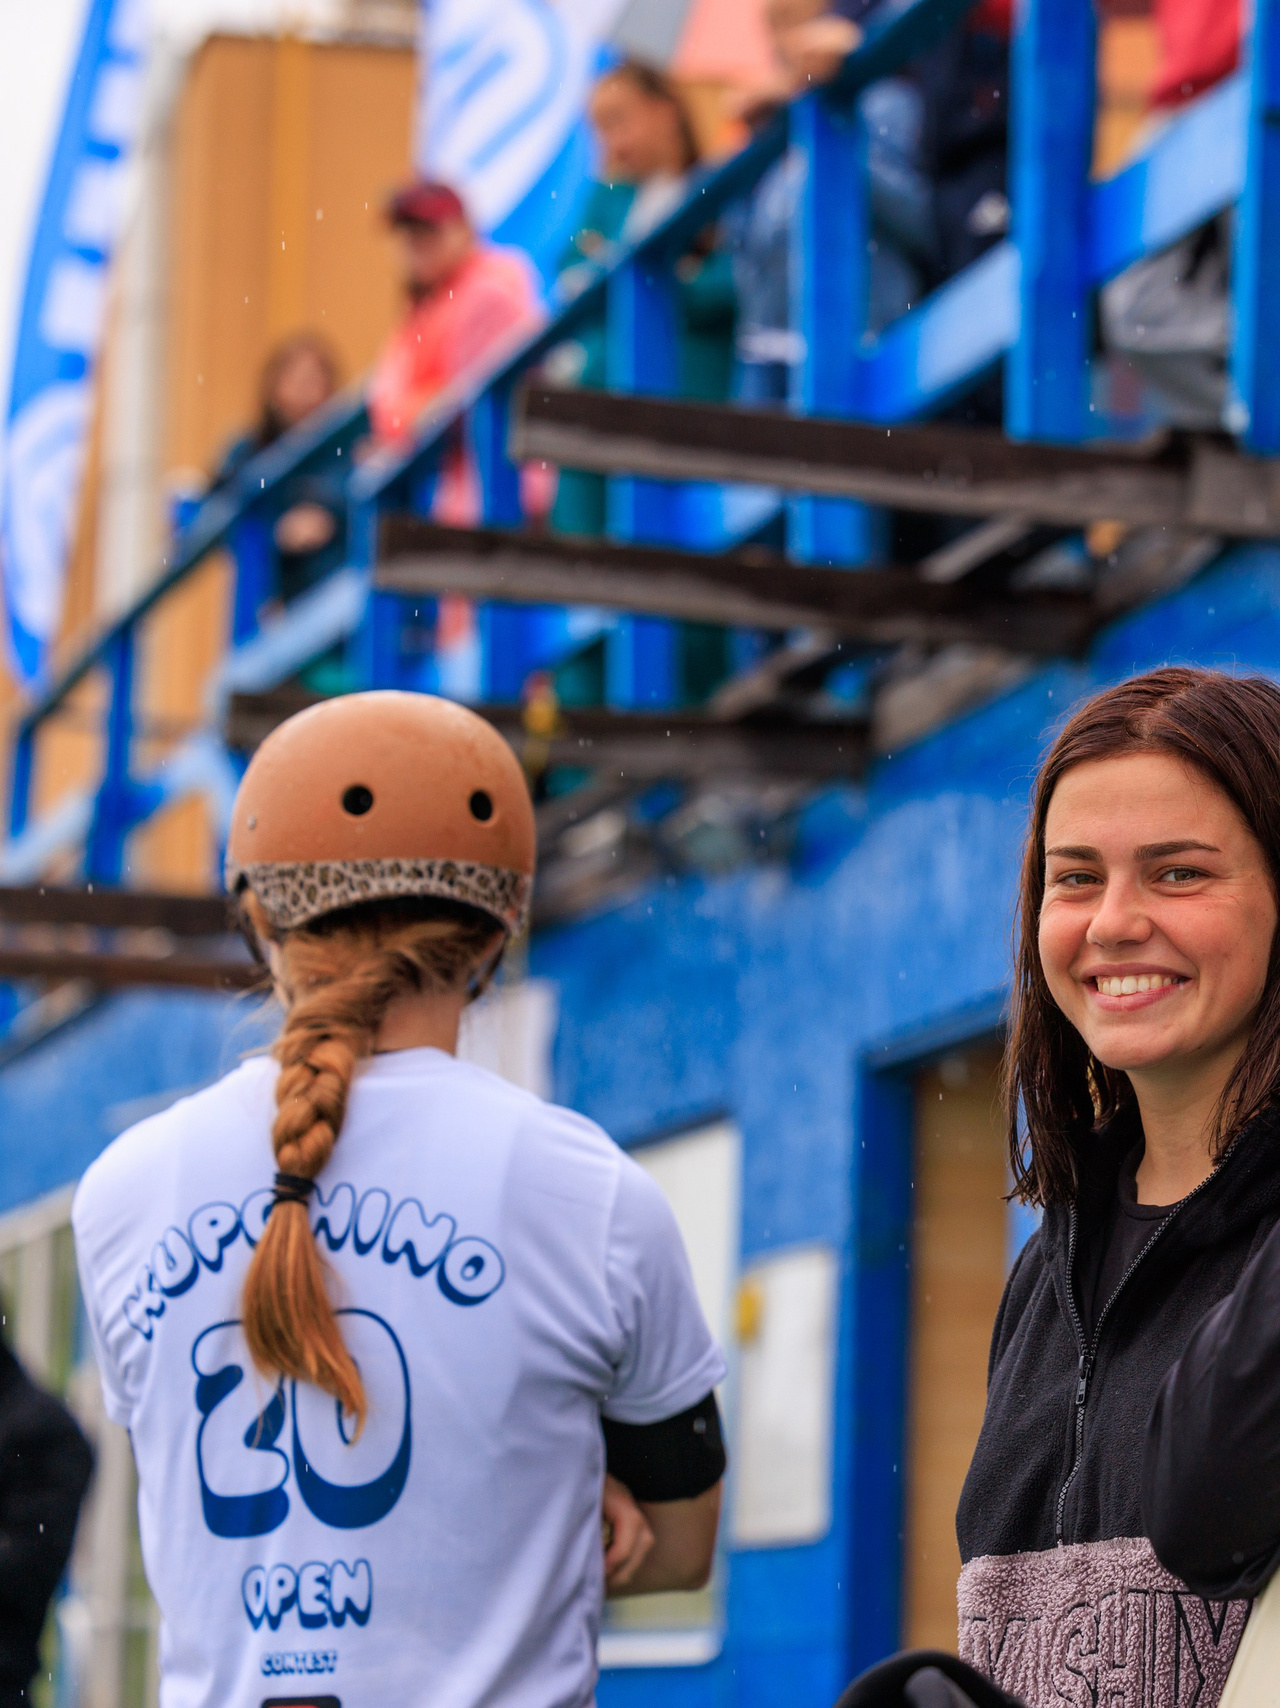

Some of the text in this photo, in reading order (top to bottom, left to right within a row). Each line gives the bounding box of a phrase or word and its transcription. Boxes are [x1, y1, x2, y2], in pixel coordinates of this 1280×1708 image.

[192, 1308, 411, 1539] 20
[242, 1558, 373, 1631] OPEN
[261, 1650, 337, 1677] CONTEST
